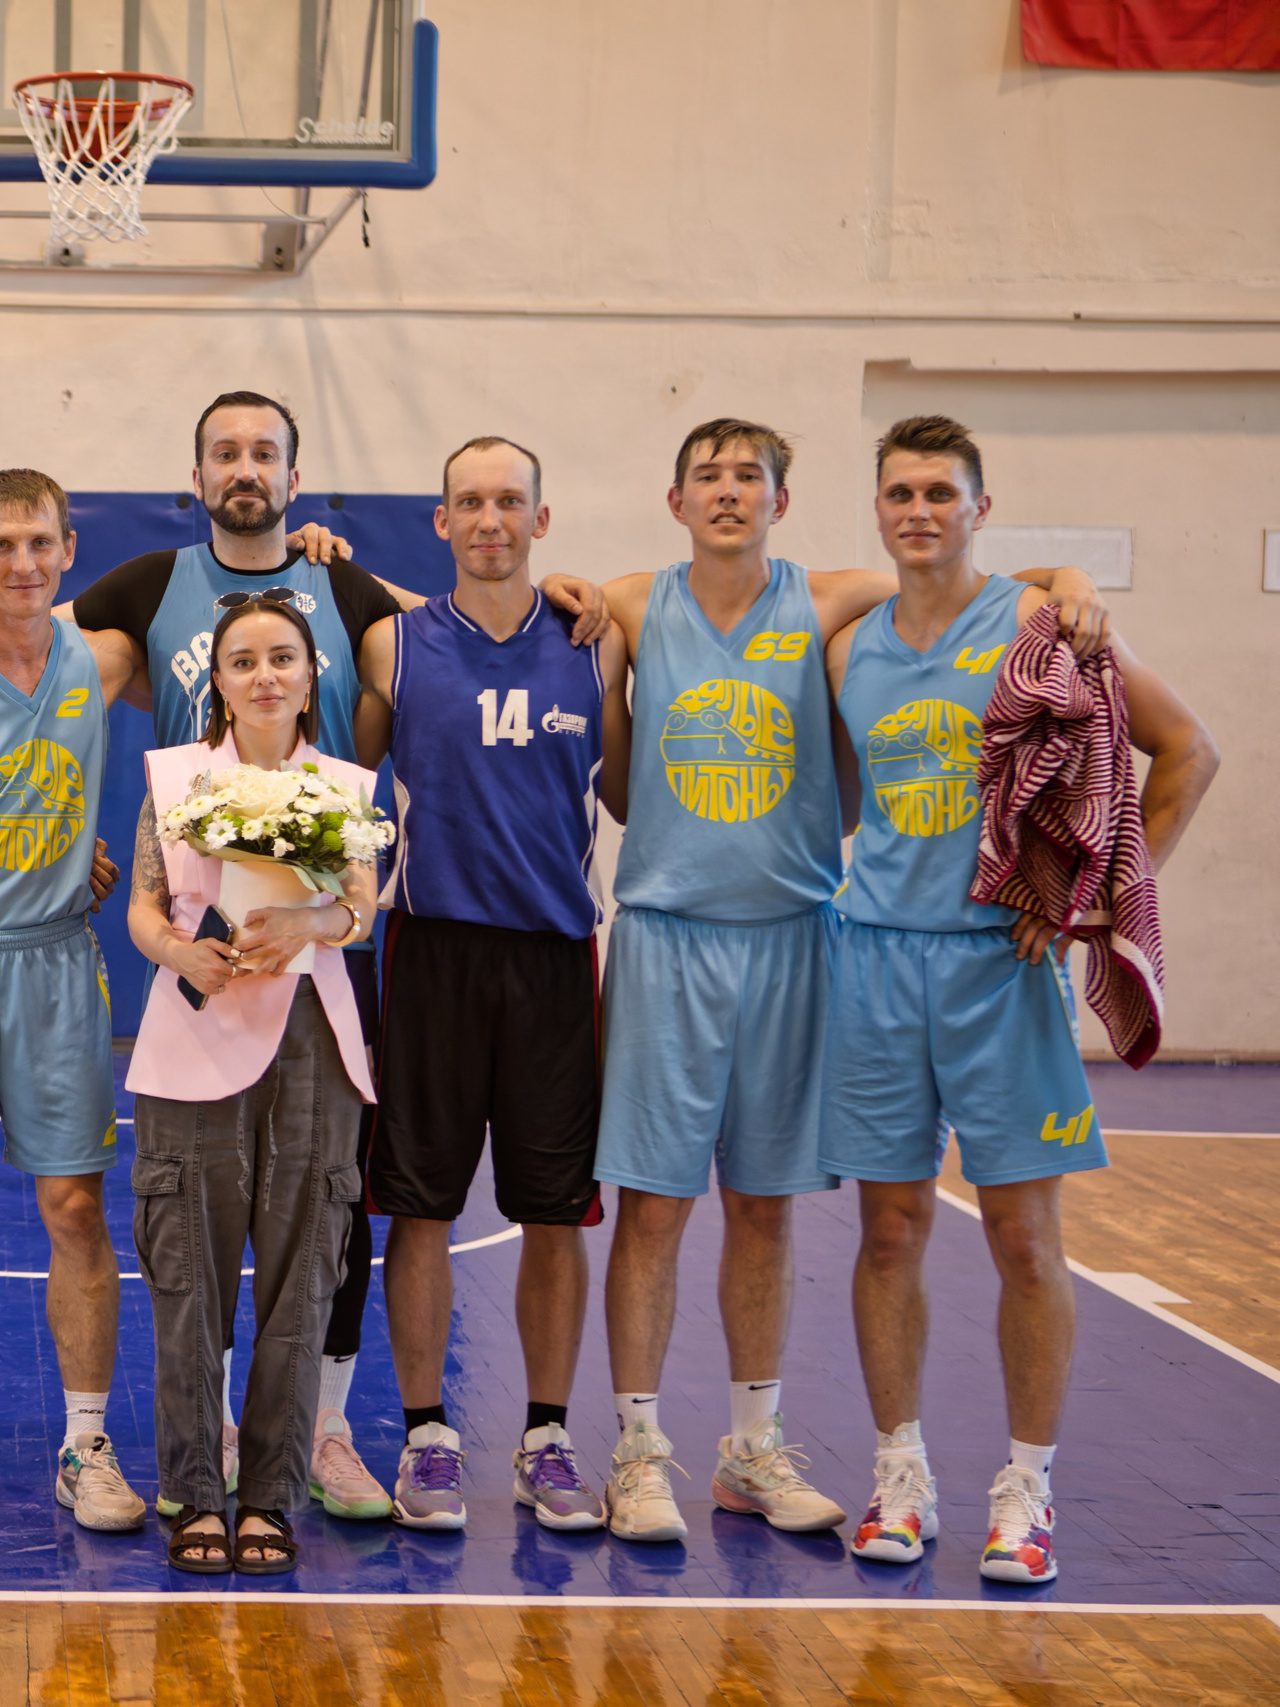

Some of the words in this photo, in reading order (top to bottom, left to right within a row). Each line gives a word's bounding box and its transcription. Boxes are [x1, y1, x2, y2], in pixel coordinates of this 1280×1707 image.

[742, 631, 812, 661] 69
[953, 643, 1008, 675] 41
[55, 688, 90, 718] 2
[477, 689, 534, 746] 14
[665, 765, 796, 823] ПИТОНЫ
[1041, 1104, 1095, 1147] 41
